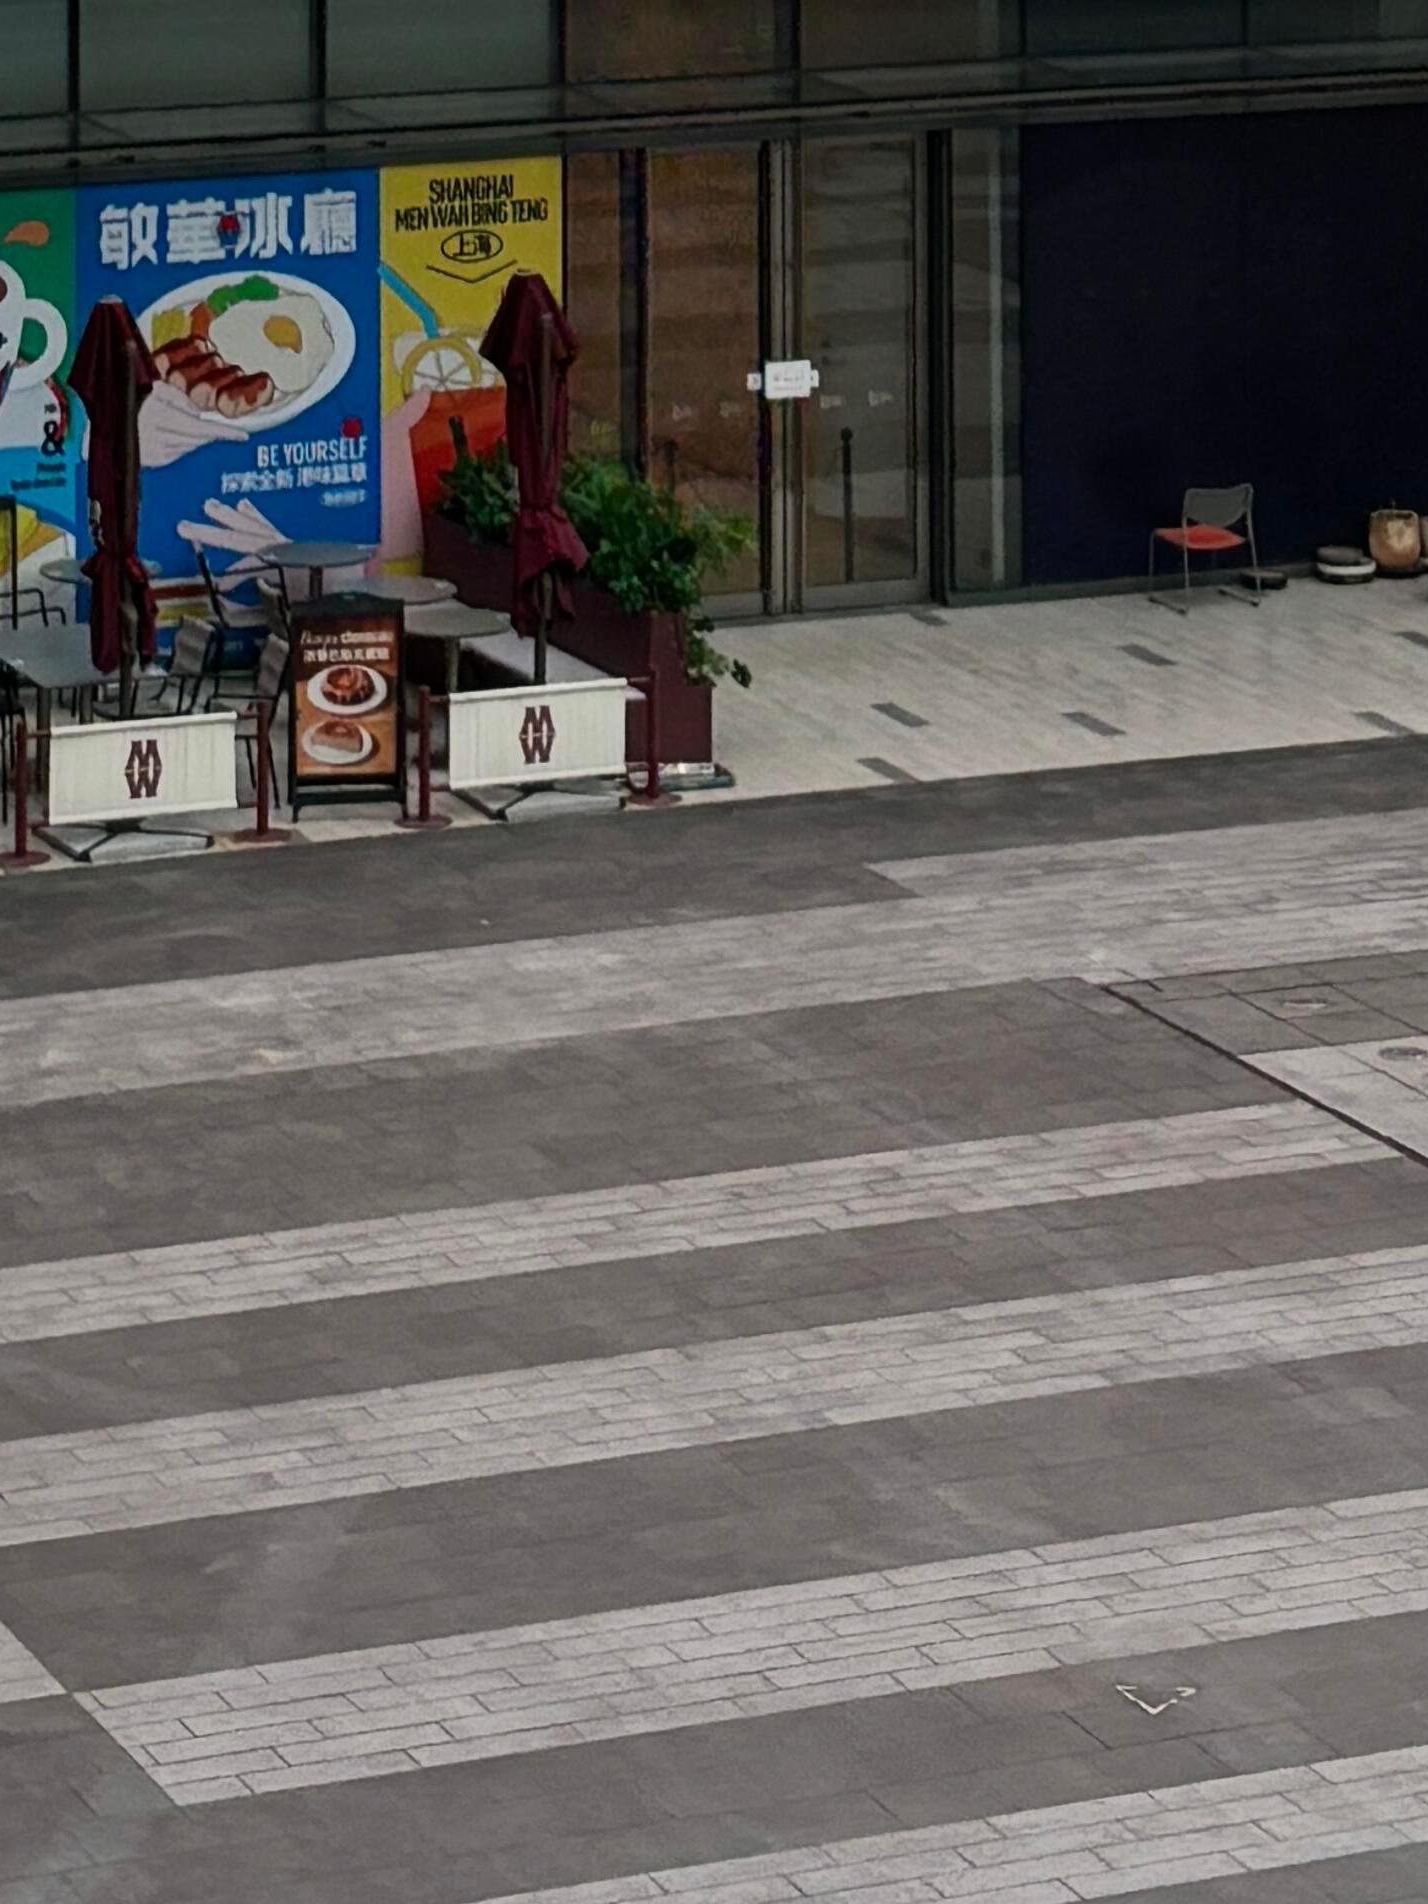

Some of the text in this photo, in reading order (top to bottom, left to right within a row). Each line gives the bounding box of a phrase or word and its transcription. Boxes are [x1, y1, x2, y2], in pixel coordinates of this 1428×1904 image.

[428, 174, 514, 205] SHANGHAI
[394, 196, 549, 233] MEN WAH BING TENG
[256, 435, 369, 469] BE YOURSELF
